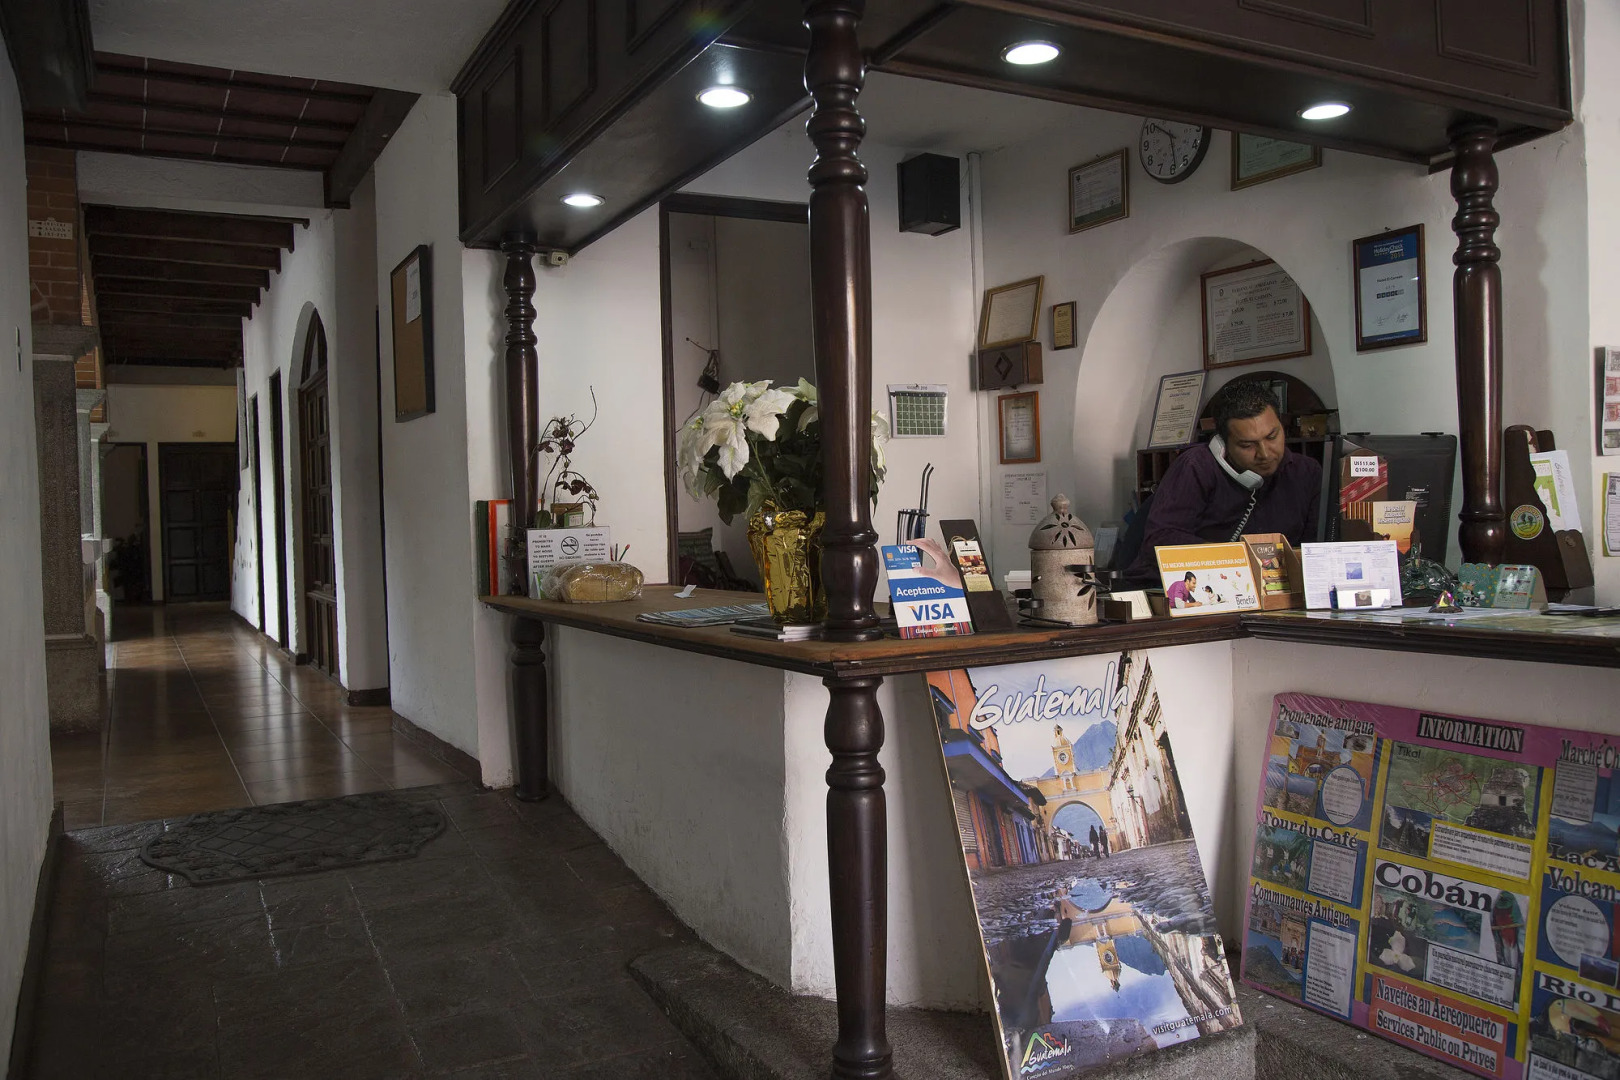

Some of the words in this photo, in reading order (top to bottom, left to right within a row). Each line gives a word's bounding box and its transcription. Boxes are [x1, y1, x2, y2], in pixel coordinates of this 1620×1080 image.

[1145, 122, 1156, 135] 10
[1143, 140, 1150, 151] 9
[1192, 138, 1199, 150] 4
[1147, 155, 1154, 166] 8
[1157, 163, 1164, 175] 7
[1169, 163, 1176, 175] 6
[1181, 155, 1189, 166] 5
[897, 546, 918, 554] VISA
[1185, 560, 1201, 568] AMIGO
[896, 586, 946, 599] Aceptamos
[1235, 595, 1257, 606] Beneful
[908, 603, 955, 622] VISA
[969, 661, 1129, 731] Guatemala
[1278, 704, 1333, 729] Promenade
[1335, 715, 1375, 737] antigua
[1419, 716, 1524, 752] INFORMATION
[1397, 745, 1422, 759] Tikal
[1559, 738, 1604, 768] Marché
[1262, 811, 1298, 832] Tour
[1299, 820, 1318, 838] du
[1321, 826, 1358, 848] Café
[1548, 843, 1598, 868] Lac
[1375, 862, 1493, 912] Cobán
[1547, 866, 1616, 902] Volcan
[1314, 900, 1351, 928] Antigua
[1540, 973, 1596, 1003] Rio
[1152, 1005, 1233, 1035] visitguatemala.com
[1376, 979, 1417, 1009] Navettes
[1418, 998, 1431, 1014] au
[1432, 998, 1497, 1039] Aereopuerto
[1028, 1038, 1072, 1066] Guatemala
[1376, 1010, 1415, 1040] Services
[1416, 1025, 1447, 1052] Public
[1448, 1040, 1460, 1054] ou
[1461, 1042, 1496, 1072] Prives
